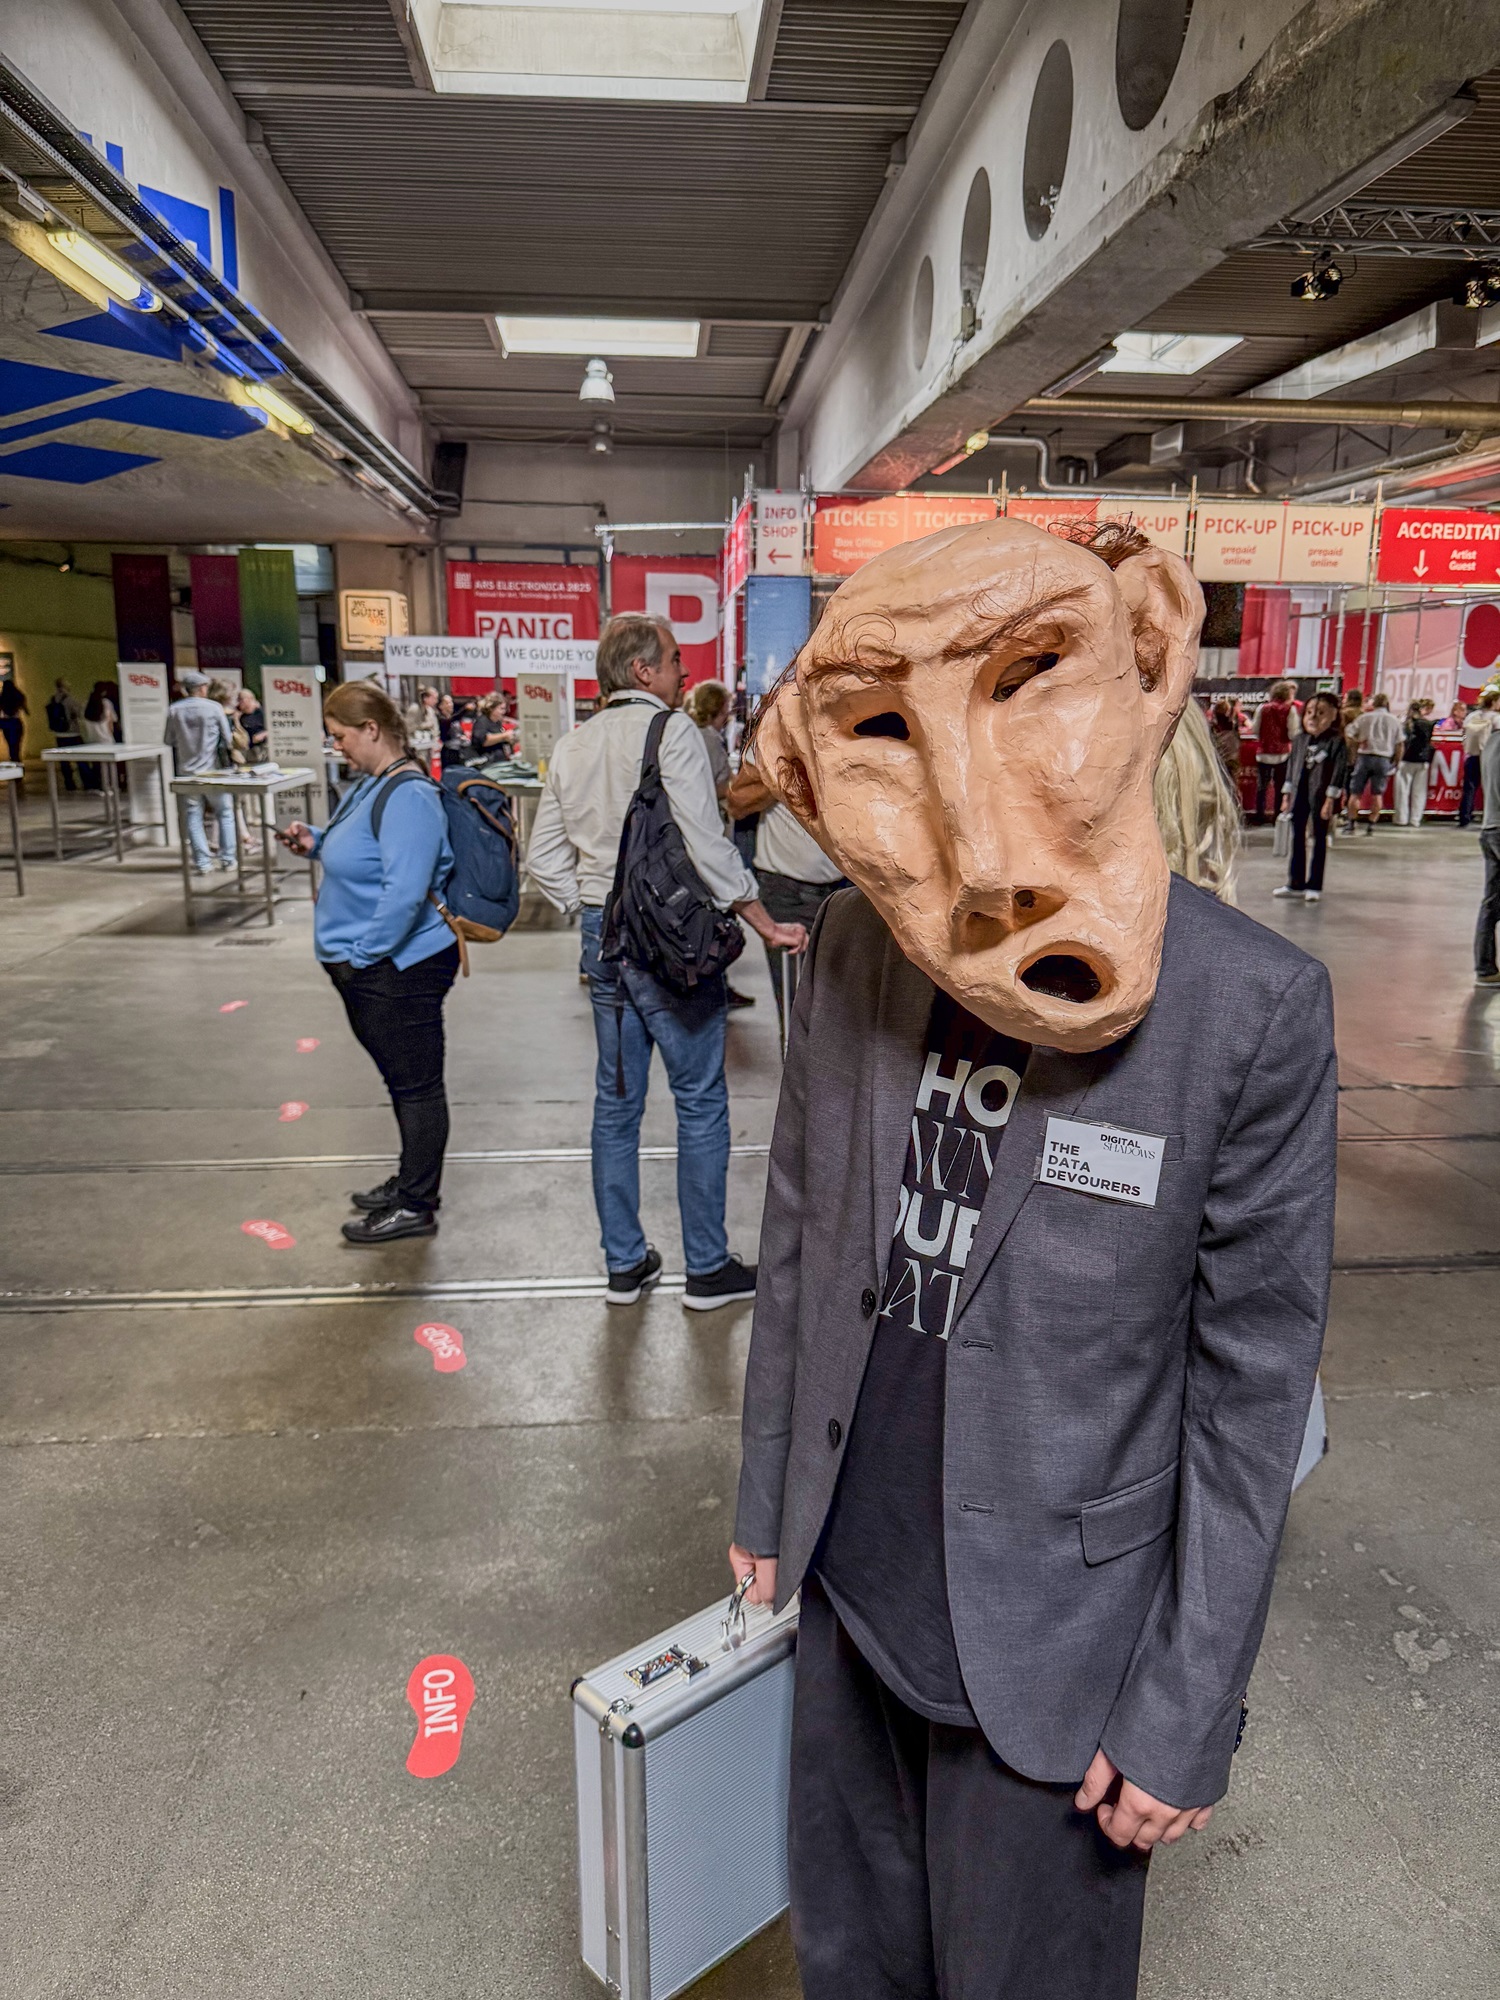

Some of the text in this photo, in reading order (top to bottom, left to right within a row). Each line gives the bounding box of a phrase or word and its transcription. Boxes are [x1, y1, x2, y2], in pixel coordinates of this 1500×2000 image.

[764, 507, 797, 520] INFO
[821, 509, 898, 528] TICKETS
[762, 526, 798, 538] SHOP
[1204, 518, 1277, 535] PICK-UP
[1292, 520, 1365, 537] PICK-UP
[1220, 545, 1257, 556] prepaid
[1307, 547, 1344, 559] prepaid
[1450, 549, 1478, 560] Artist
[1223, 557, 1252, 567] online
[1310, 559, 1339, 569] online
[1448, 560, 1477, 571] Guest
[474, 581, 495, 591] ARS
[496, 581, 565, 592] ELECTRONICA
[478, 616, 570, 640] PANIC
[389, 644, 490, 660] WE GUIDE YOU
[506, 648, 595, 662] WE GUIDE YO
[1050, 1141, 1080, 1156] THE
[1100, 1134, 1141, 1149] DIGITAL
[1103, 1142, 1156, 1161] SHADOWS
[1048, 1155, 1091, 1173] DATA
[1046, 1168, 1141, 1197] DEVOURERS
[422, 1327, 461, 1359] SHOP
[422, 1668, 458, 1738] INFO
